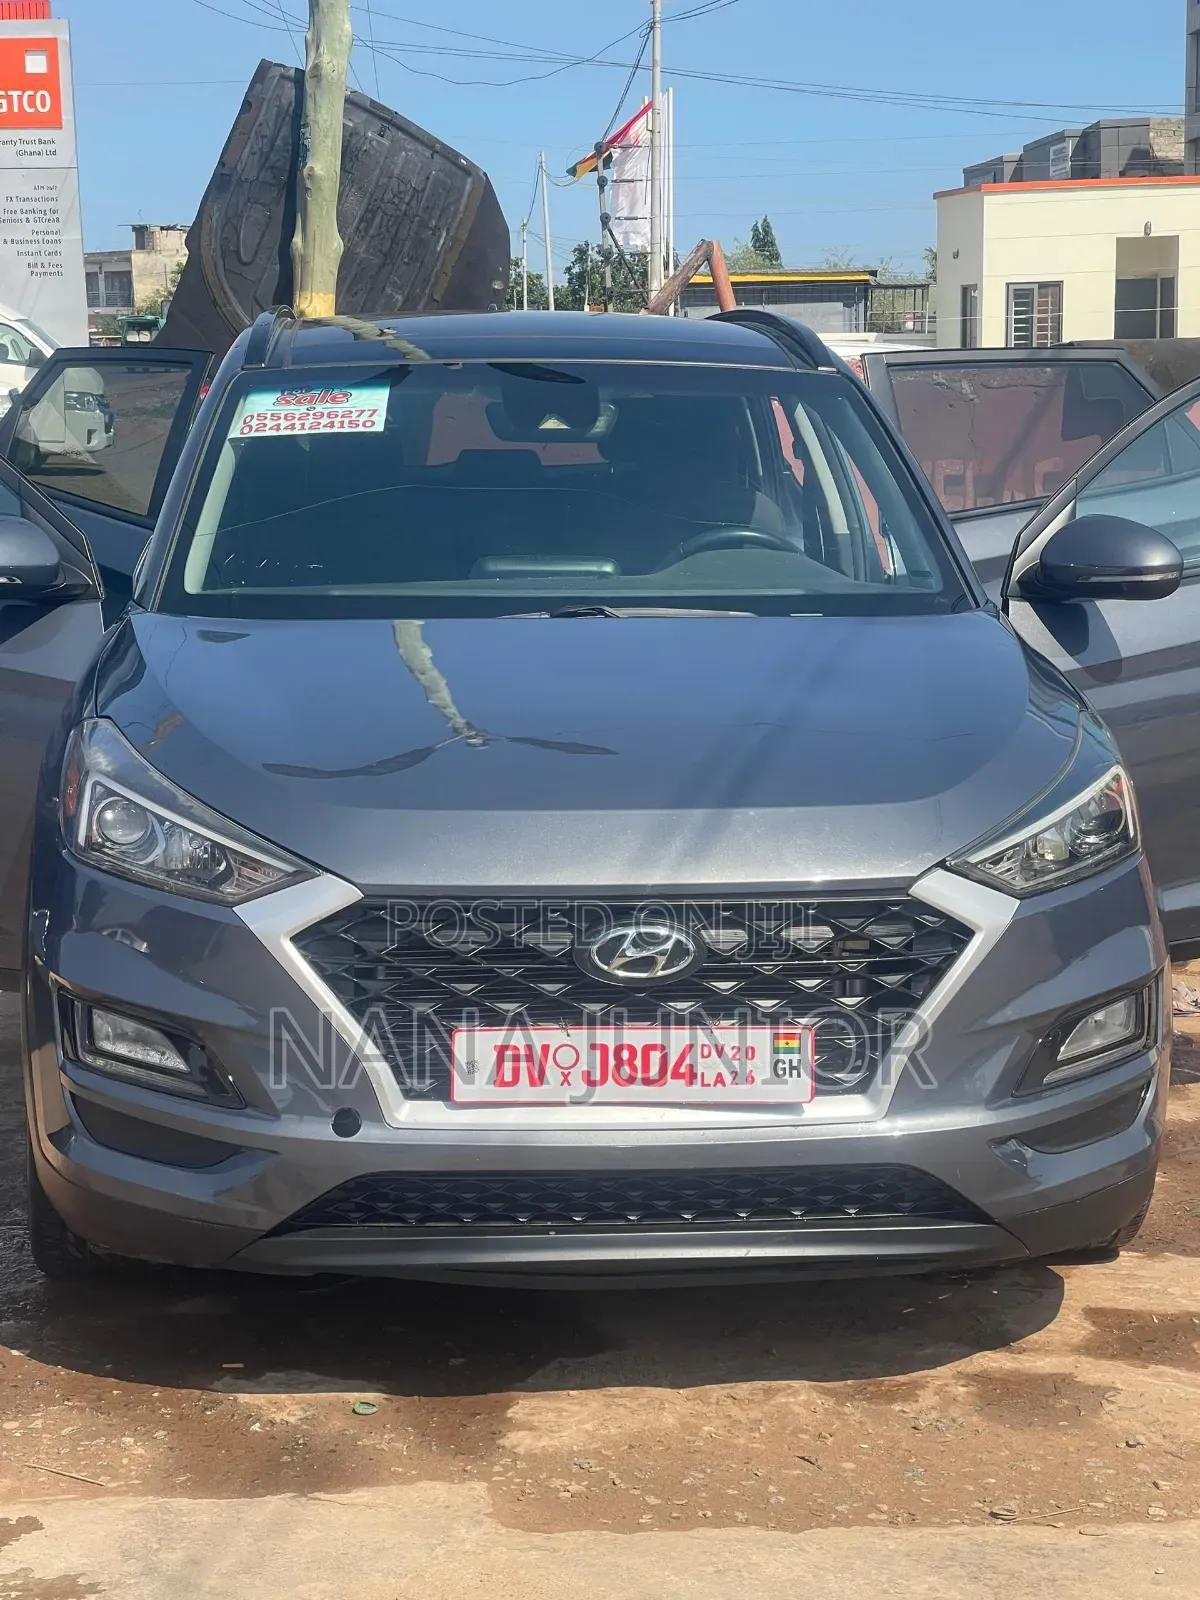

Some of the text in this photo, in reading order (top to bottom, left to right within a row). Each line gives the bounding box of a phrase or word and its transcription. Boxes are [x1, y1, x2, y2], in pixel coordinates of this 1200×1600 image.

[0, 90, 51, 113] GTCO
[38, 137, 56, 145] Bank
[16, 149, 43, 157] (Ghana)
[19, 208, 47, 216] Banking
[30, 270, 64, 278] Payments
[273, 388, 352, 406] sale
[242, 409, 379, 425] 0556296277
[239, 420, 376, 435] 0244124150
[772, 1058, 802, 1079] GH
